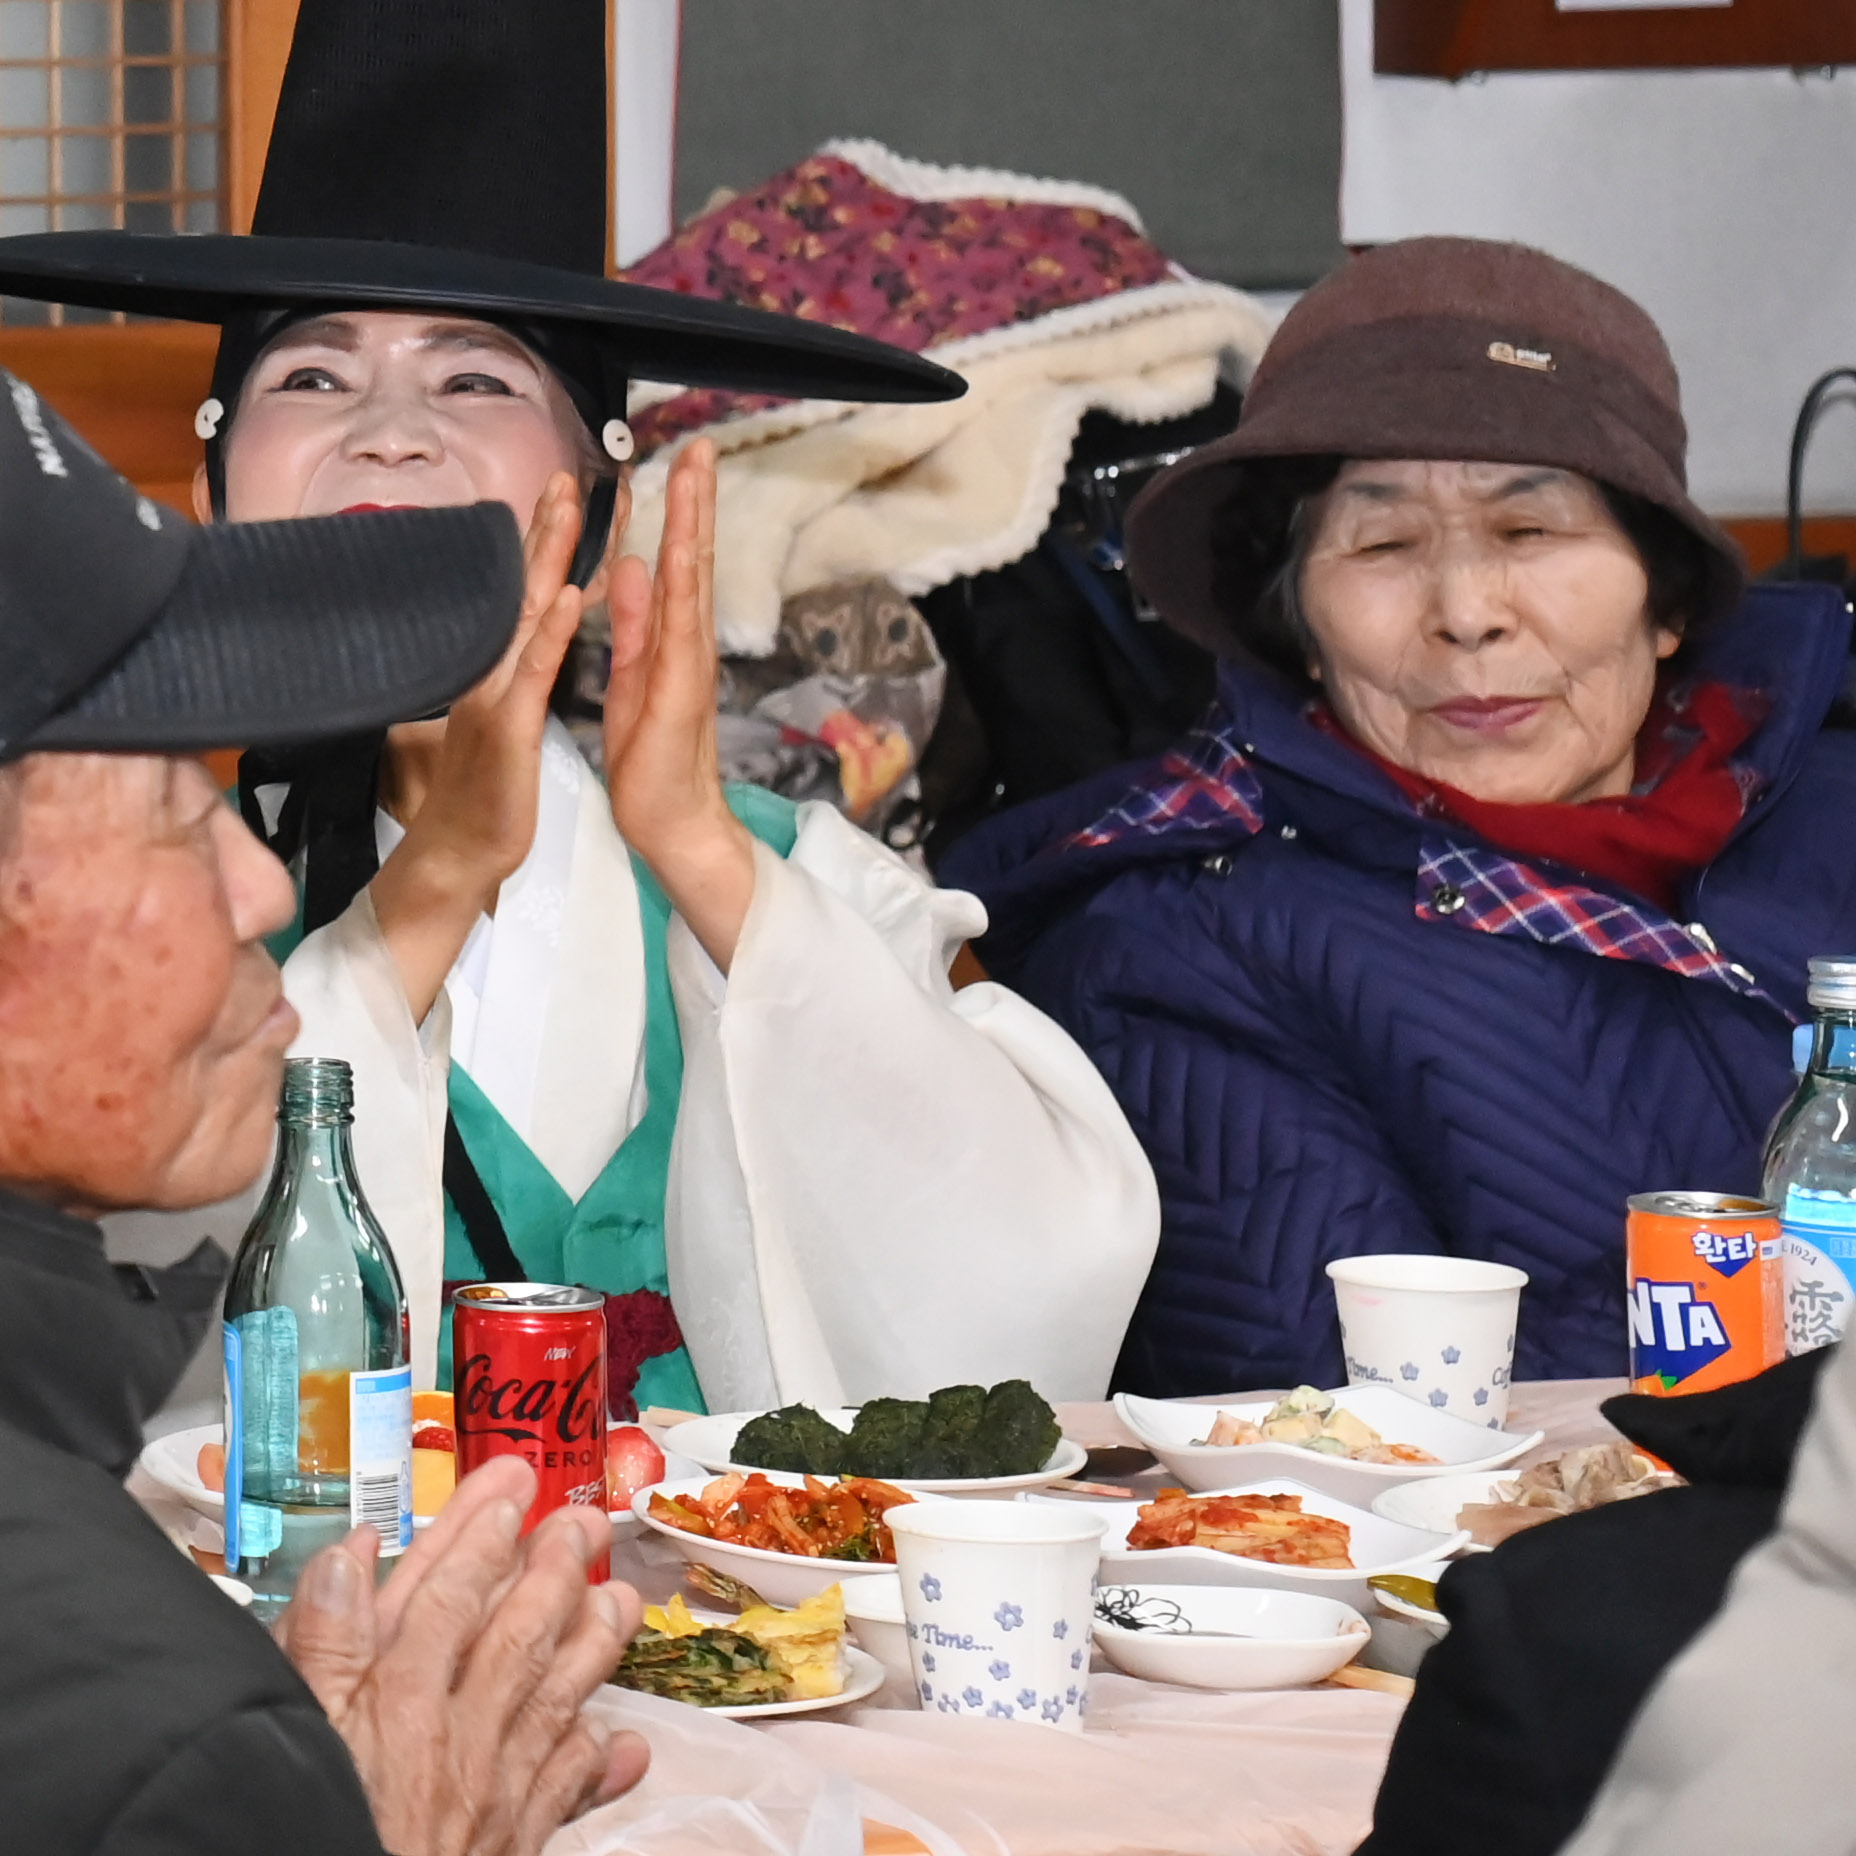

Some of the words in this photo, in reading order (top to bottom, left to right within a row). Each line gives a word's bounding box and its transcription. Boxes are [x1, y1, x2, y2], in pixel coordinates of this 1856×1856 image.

[1693, 1231, 1757, 1263] 환타
[1790, 1242, 1818, 1266] 1924
[524, 1450, 592, 1469] ZERO
